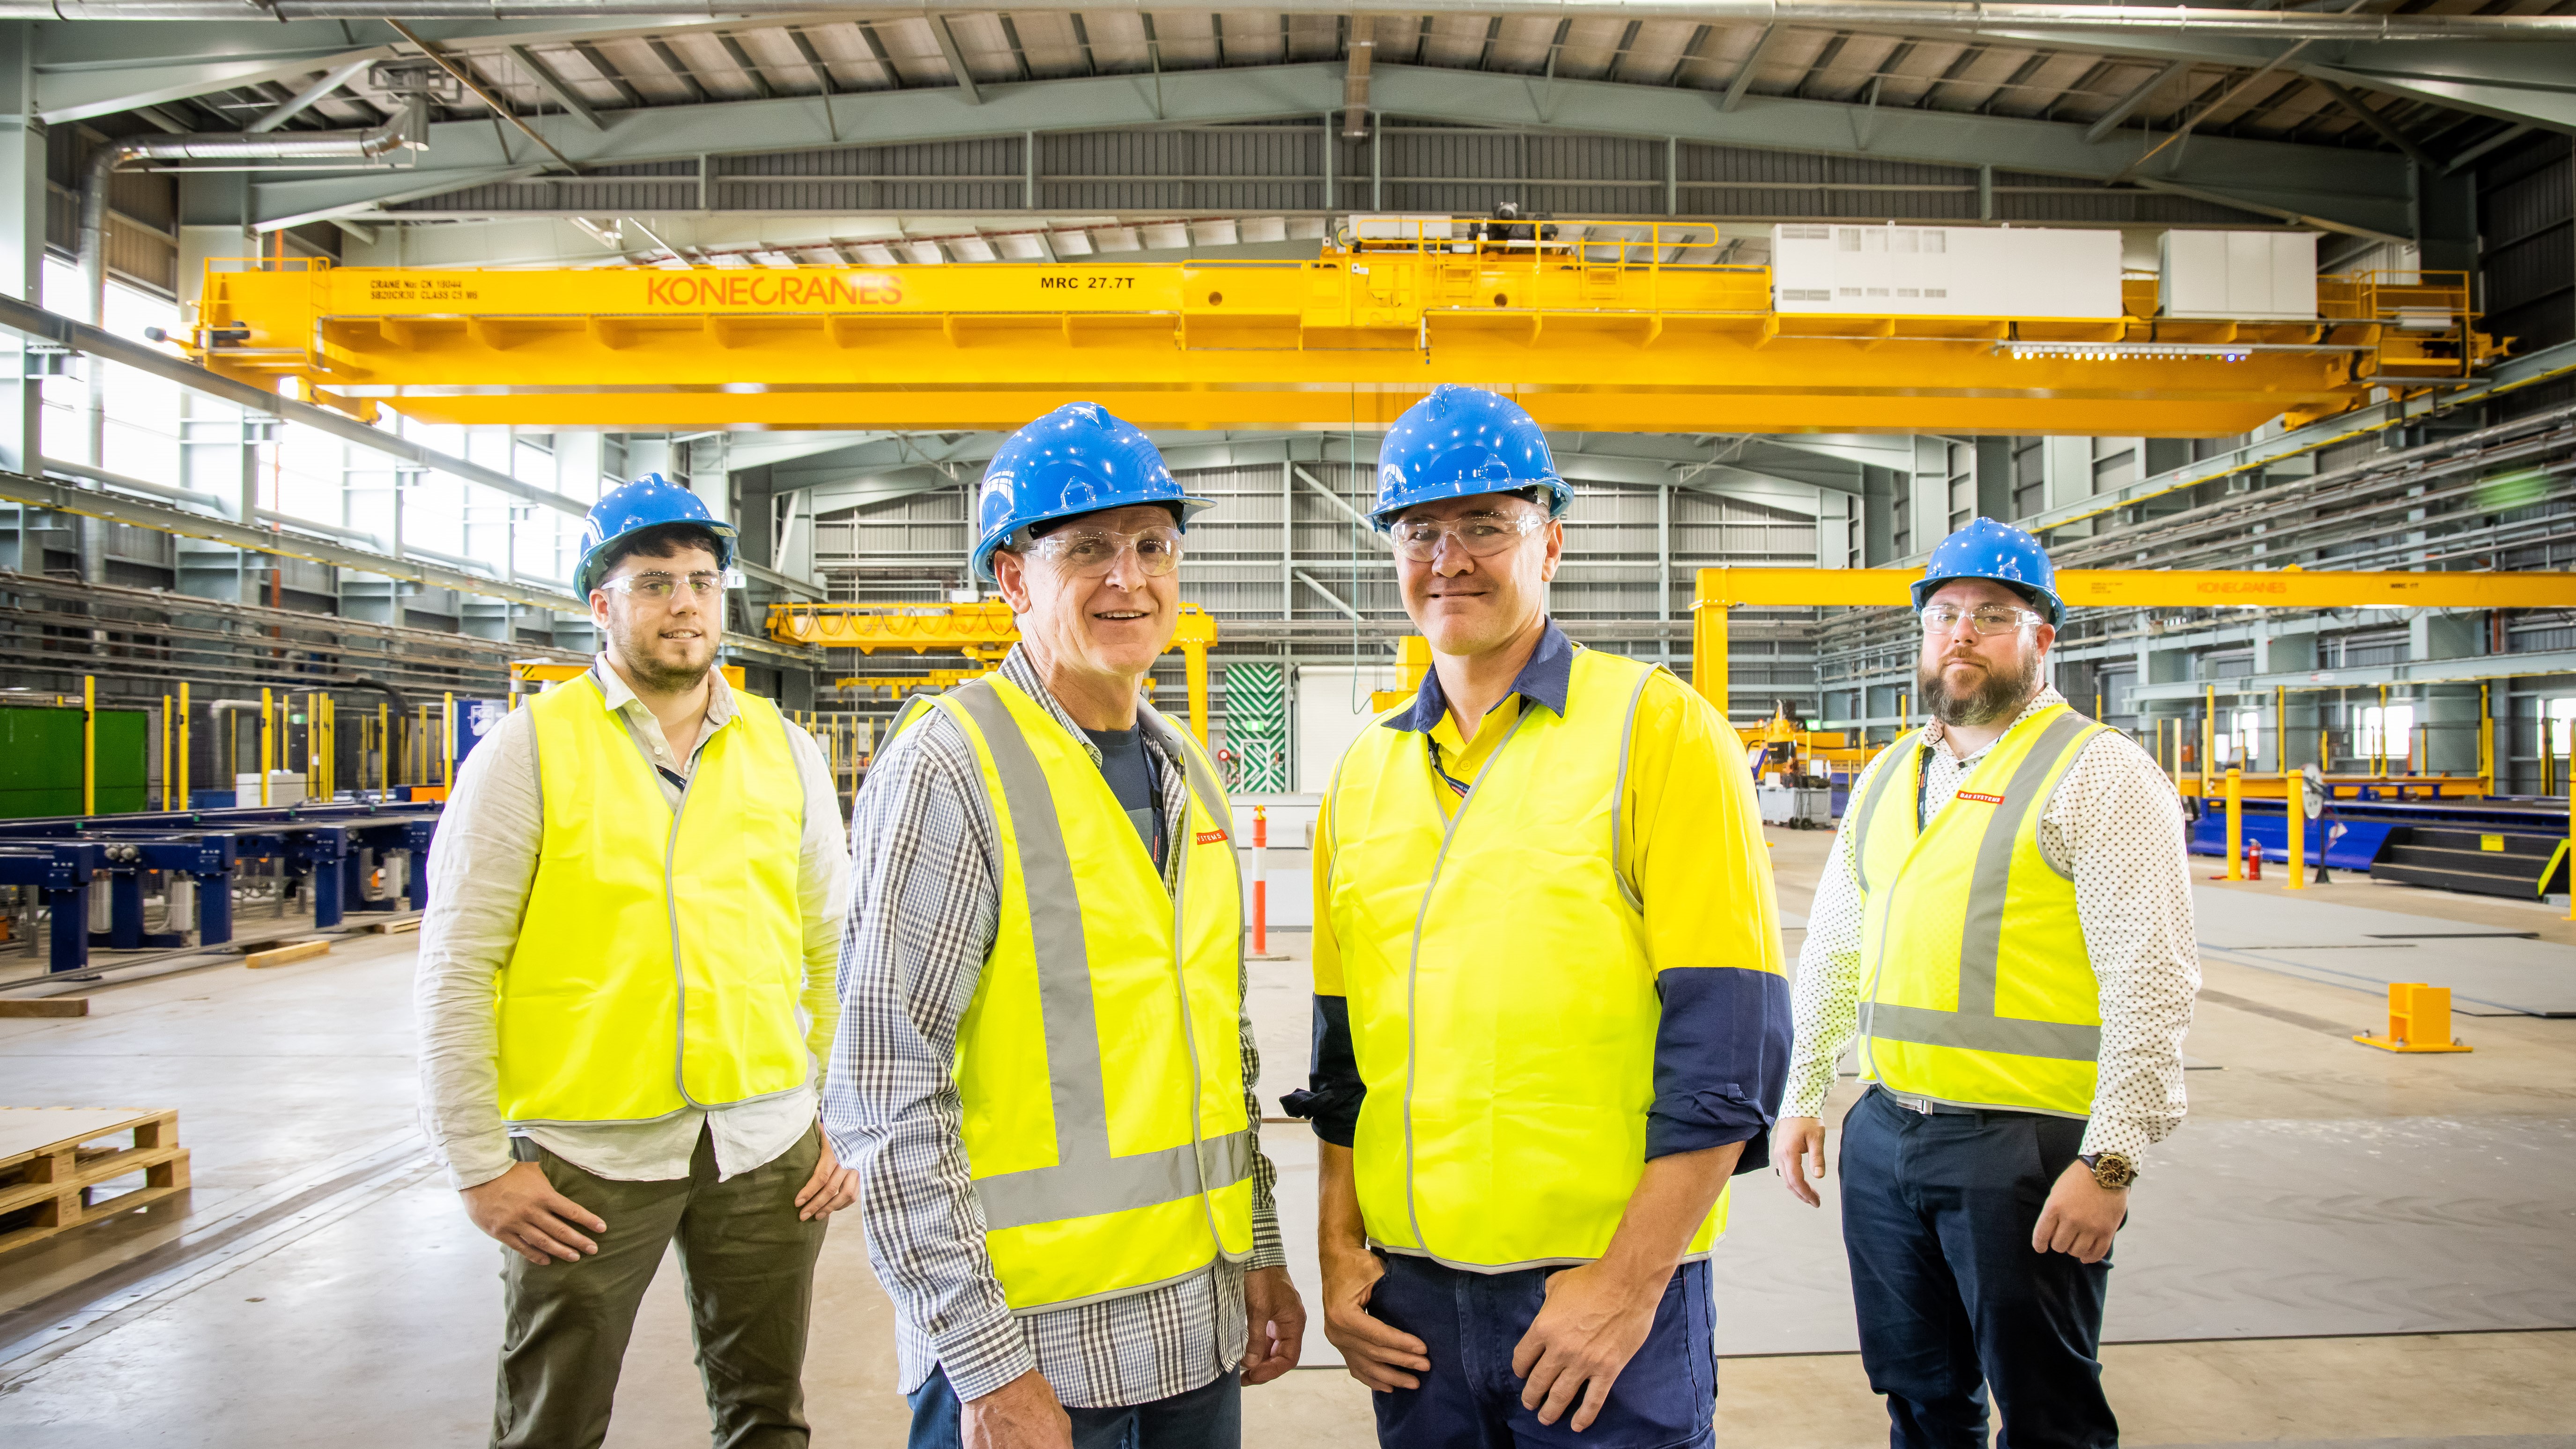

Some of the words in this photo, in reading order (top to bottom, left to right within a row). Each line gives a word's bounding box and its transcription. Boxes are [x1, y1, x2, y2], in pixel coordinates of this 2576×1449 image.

[370, 280, 400, 288] CRANE
[1041, 277, 1079, 288] MRC
[1088, 277, 1135, 288] 27.7T
[420, 290, 448, 300] CLASS
[648, 276, 902, 305] KONECRANES
[2197, 582, 2287, 593] KONECRANES
